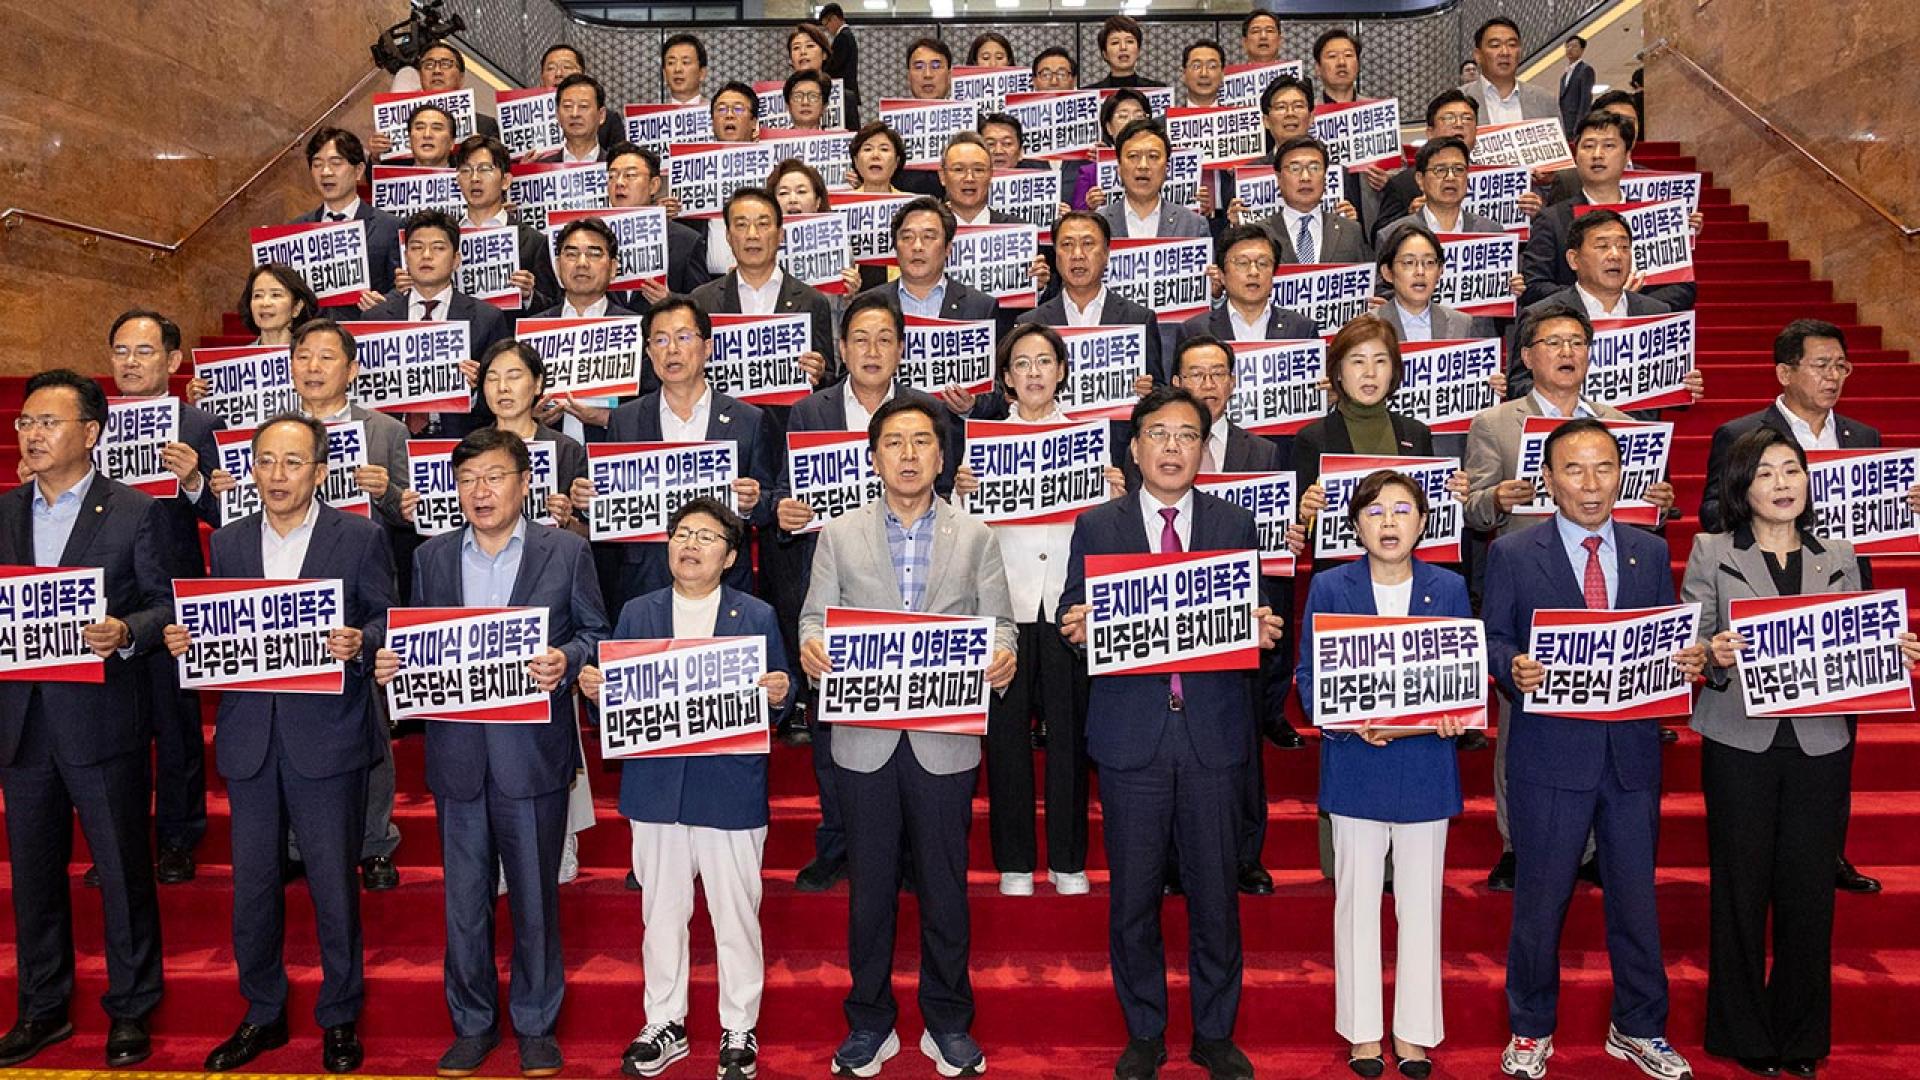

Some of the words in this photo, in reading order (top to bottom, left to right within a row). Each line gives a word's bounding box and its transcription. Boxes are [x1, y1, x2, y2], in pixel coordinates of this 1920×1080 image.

[500, 103, 544, 132] 묻지마식
[758, 93, 786, 121] 묻지마
[930, 106, 974, 134] 의회폭주
[1056, 98, 1098, 123] 의회폭주
[1218, 110, 1260, 136] 의회폭주
[1353, 104, 1396, 135] 의회폭주
[629, 116, 672, 145] 묻지마식
[902, 136, 926, 160] 당식
[1021, 126, 1052, 155] 주당식
[1057, 120, 1099, 152] 협치파괴
[1219, 132, 1261, 160] 협치파괴
[1329, 140, 1350, 166] 당식
[1354, 129, 1398, 160] 협치파괴
[672, 155, 718, 187] 묻지마식
[722, 149, 769, 180] 의회폭주
[773, 142, 805, 167] 지마식
[375, 179, 421, 206] 묻지마식
[509, 176, 556, 207] 묻지마식
[1010, 176, 1057, 204] 의회폭주
[1240, 180, 1279, 210] 묻지마
[1480, 170, 1527, 201] 의회폭주
[792, 219, 844, 254] 의회폭주
[849, 205, 874, 231] 마식
[1631, 205, 1685, 240] 의회폭주
[308, 227, 361, 262] 의회폭주
[462, 232, 514, 265] 의회폭주
[850, 232, 874, 257] 당식
[980, 231, 1033, 264] 의회폭주
[1461, 240, 1513, 273] 의회폭주
[1634, 233, 1687, 271] 협치파괴
[312, 256, 364, 293] 협치파괴
[980, 260, 1032, 293] 협치파괴
[1104, 252, 1149, 286] 지마식
[1154, 244, 1208, 282] 의회폭주
[1154, 274, 1208, 308] 협치파괴
[1272, 276, 1312, 306] 지마식
[1316, 269, 1370, 302] 의회폭주
[1460, 269, 1513, 302] 협치파괴
[358, 336, 401, 371] 지마식
[406, 328, 464, 366] 의회폭주
[580, 323, 638, 360] 의회폭주
[711, 331, 742, 366] 마식
[746, 321, 806, 360] 의회폭주
[930, 326, 991, 359] 의회폭주
[1079, 333, 1139, 371] 의회폭주
[1589, 331, 1634, 368] 지마식
[1638, 319, 1691, 361] 의회폭주
[260, 356, 290, 390] 의회
[405, 360, 466, 396] 협치파괴
[543, 361, 573, 388] 당식
[577, 351, 636, 385] 협치파괴
[898, 361, 927, 394] 당식
[931, 354, 990, 389] 협치파괴
[1262, 347, 1321, 384] 의회폭주
[1403, 355, 1432, 394] 마식
[1436, 345, 1497, 384] 의회폭주
[1582, 364, 1633, 404] 주당식
[1637, 353, 1691, 394] 협치파괴
[1228, 389, 1259, 424] 당식
[1262, 381, 1322, 420] 협치파괴
[1387, 390, 1431, 422] 주당식
[1436, 379, 1495, 418] 협치파괴
[108, 404, 174, 446] 의회폭주
[329, 428, 361, 468] 폭주
[969, 440, 1036, 479] 묻지마식
[1041, 428, 1106, 473] 의회폭주
[1618, 431, 1666, 472] 회폭주
[413, 459, 456, 499] 묻지
[593, 455, 661, 497] 묻지마식
[666, 448, 735, 489] 의회폭주
[794, 447, 860, 491] 묻지마식
[1041, 464, 1105, 509] 협치파괴
[1809, 465, 1846, 504] 마식
[1850, 457, 1916, 500] 의회폭주
[227, 480, 259, 519] 민주
[416, 495, 467, 530] 민주당
[1324, 476, 1357, 513] 묻지
[594, 493, 661, 534] 민주당식
[1321, 514, 1359, 551] 민주
[1424, 503, 1456, 542] 파괴
[1814, 504, 1846, 541] 당식
[1256, 518, 1292, 554] 파괴
[21, 577, 97, 622] 의회폭주
[1091, 572, 1169, 624] 묻지마식
[1175, 560, 1252, 611] 의회폭주
[181, 597, 257, 640] 묻지마식
[262, 587, 337, 632] 의회폭주
[1736, 613, 1817, 665] 묻지마식
[1821, 599, 1902, 650] 의회폭주
[467, 615, 542, 662] 의회폭주
[828, 631, 906, 674] 묻지마식
[910, 627, 988, 671] 의회폭주
[1093, 615, 1170, 666] 민주당식
[1176, 601, 1252, 652] 협치파괴
[1319, 631, 1396, 675] 묻지마식
[1402, 625, 1480, 667] 의회폭주
[1534, 629, 1617, 668] 묻지마식
[1620, 613, 1695, 665] 의회폭주
[185, 635, 259, 679] 민주당식
[1743, 656, 1820, 706] 민주당식
[1823, 642, 1905, 694] 협치파괴
[392, 667, 464, 710] 민주당식
[604, 656, 680, 708] 묻지마식
[685, 644, 761, 694] 의회폭주
[825, 671, 902, 714] 민주당식
[907, 668, 985, 711] 협치파괴
[1319, 669, 1396, 716] 민주당식
[1402, 660, 1480, 707] 협치파괴
[605, 699, 681, 749] 민주당식
[687, 686, 762, 736] 협치파괴
